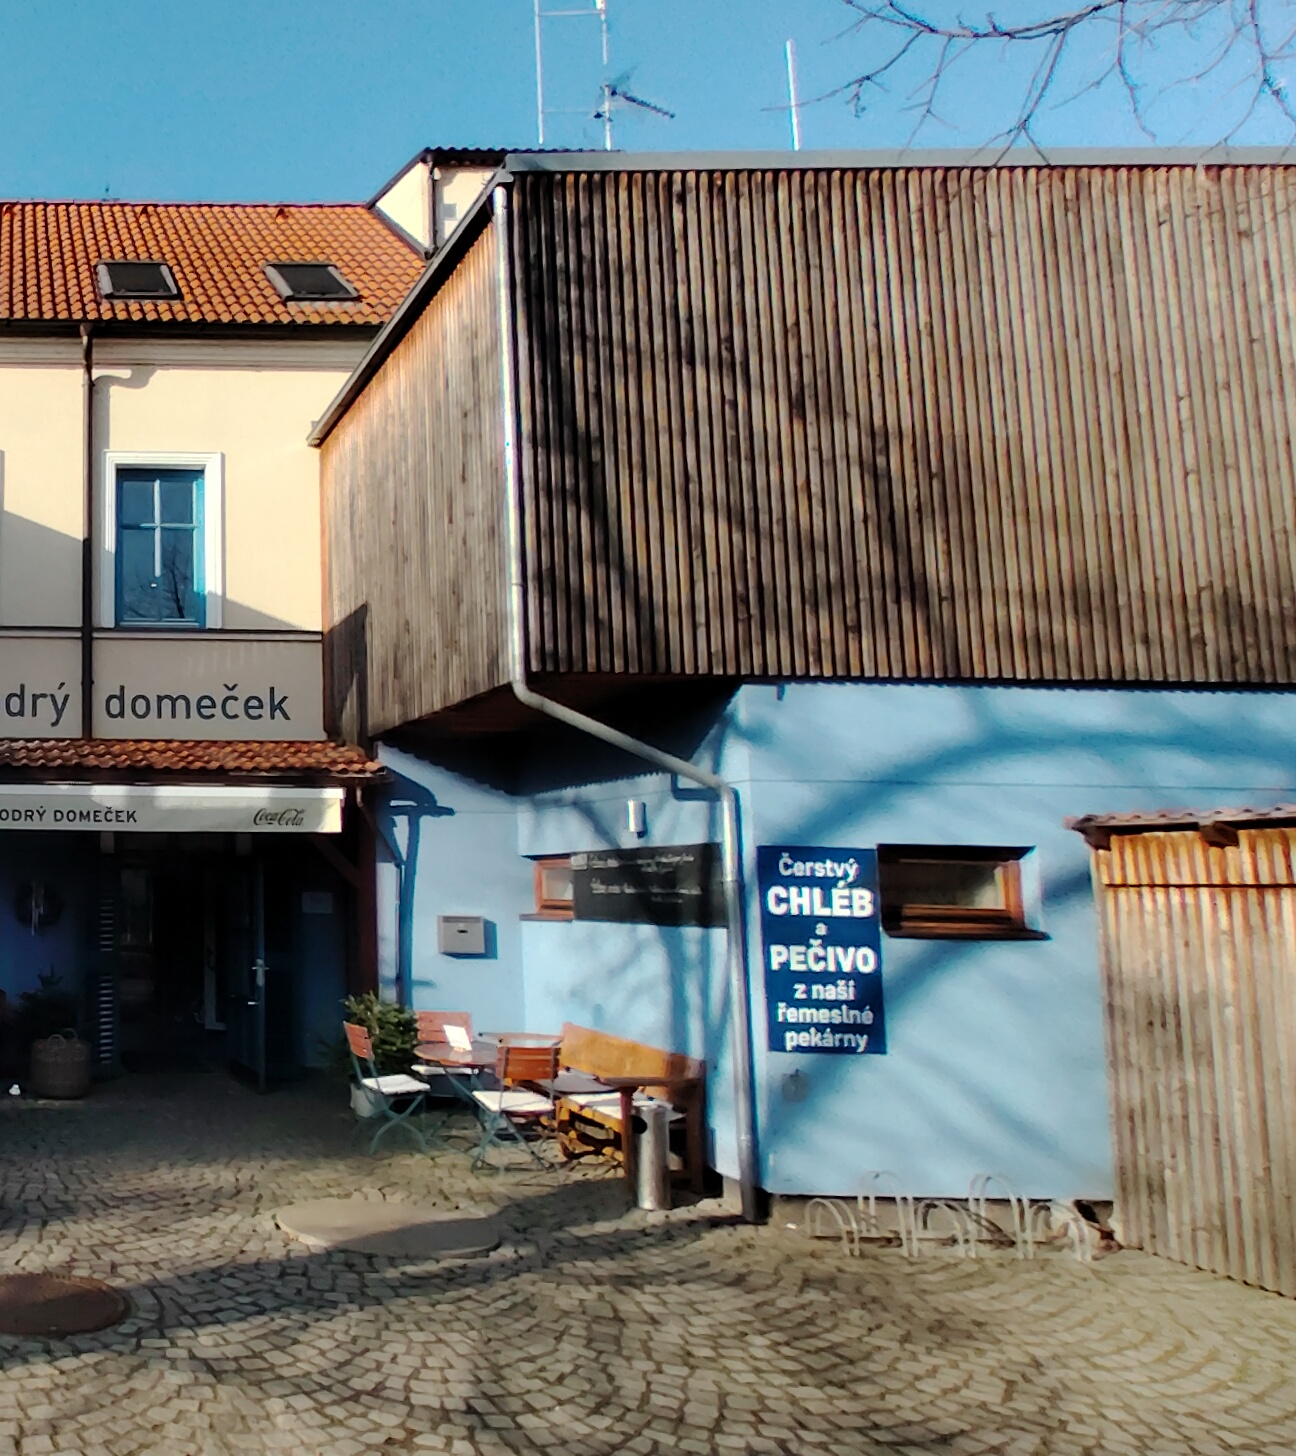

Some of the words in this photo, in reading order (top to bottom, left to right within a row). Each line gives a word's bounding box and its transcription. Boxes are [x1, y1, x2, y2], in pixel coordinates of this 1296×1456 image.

[105, 683, 291, 721] domeček
[53, 807, 138, 824] DOMEČEK
[778, 852, 860, 882] Čerstvý
[767, 880, 875, 918] CHLÉB
[815, 922, 828, 936] a
[770, 938, 876, 974] PEČIVO
[793, 983, 808, 999] z
[811, 979, 856, 1000] naši
[777, 1001, 874, 1025] řemeslné
[785, 1026, 869, 1053] pekárny
